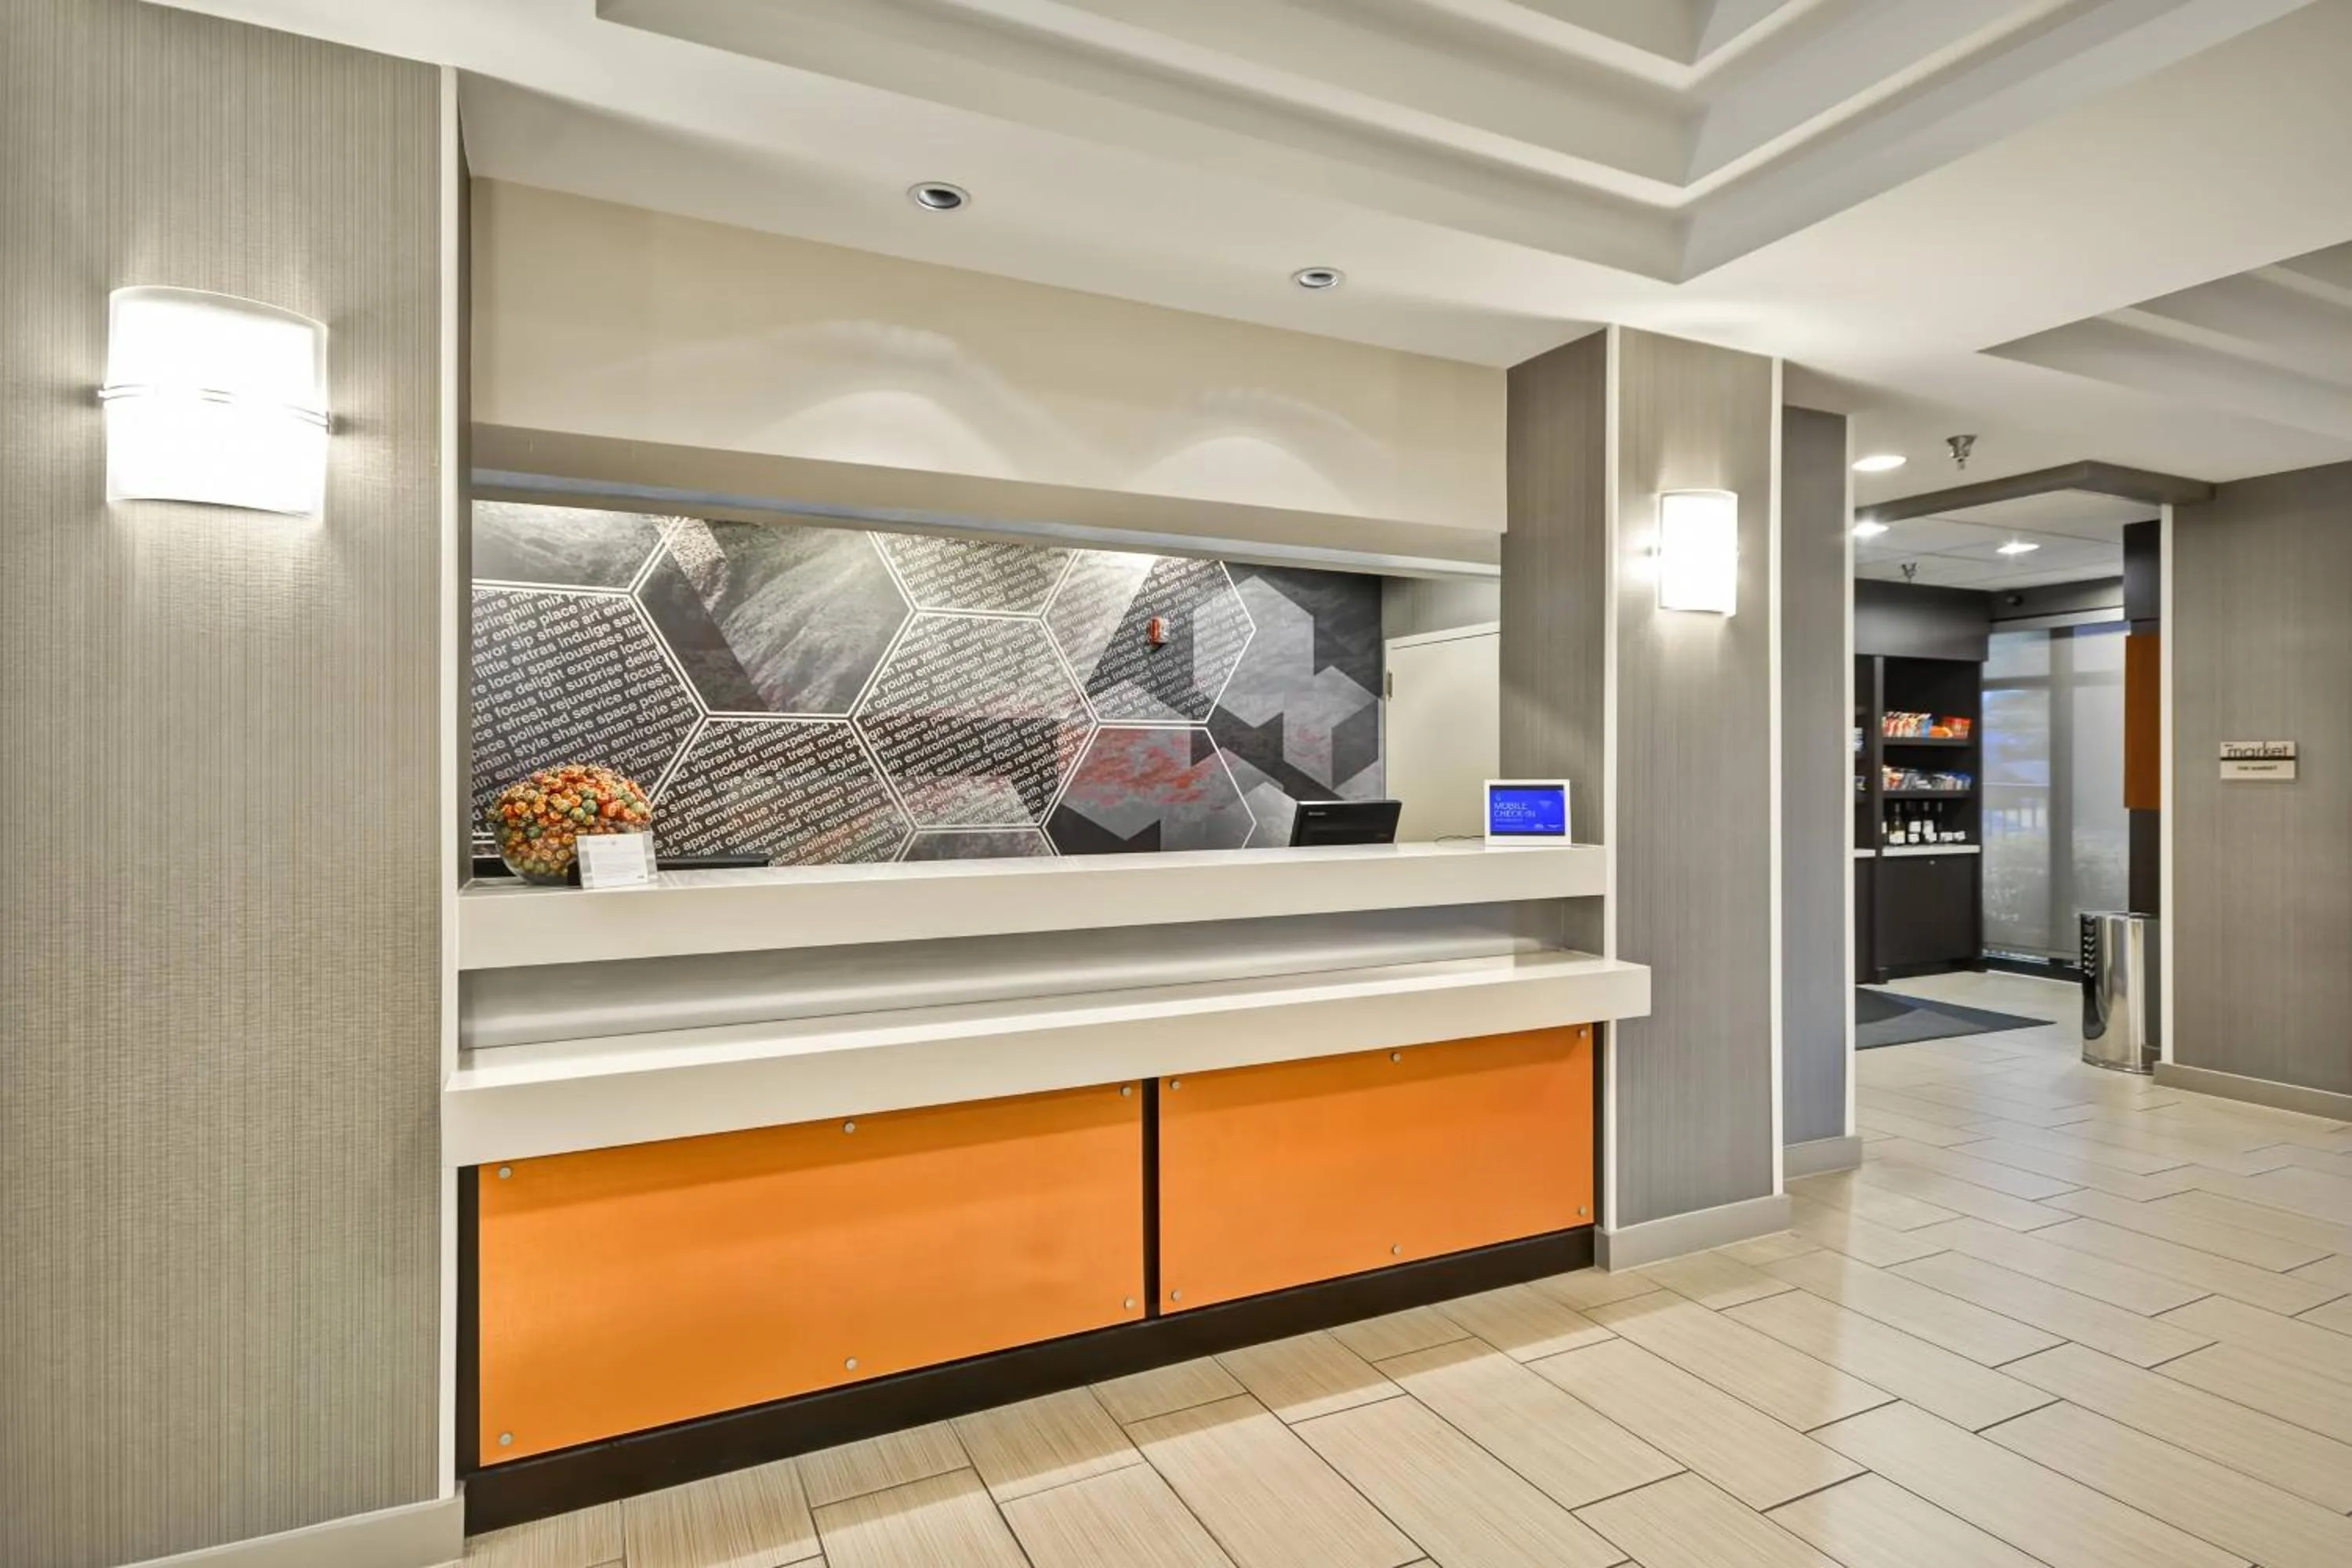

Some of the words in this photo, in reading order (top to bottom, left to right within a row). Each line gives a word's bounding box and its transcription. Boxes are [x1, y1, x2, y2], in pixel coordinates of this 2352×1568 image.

[937, 557, 964, 574] local
[951, 577, 982, 595] focus
[984, 569, 1003, 581] fun
[1182, 568, 1214, 586] human
[492, 619, 537, 642] entice
[539, 605, 576, 629] place
[538, 594, 562, 610] mix
[1152, 599, 1171, 612] hue
[1173, 586, 1199, 604] youth
[475, 660, 508, 679] little
[512, 642, 557, 666] extras
[557, 623, 610, 648] indulge
[512, 635, 532, 649] sip
[537, 620, 578, 641] shake
[582, 608, 601, 624] art
[932, 622, 969, 643] human
[488, 666, 524, 689] local
[528, 633, 623, 675] spaciousness
[515, 668, 564, 695] delight
[567, 650, 618, 676] explore
[875, 679, 928, 707] optimistic
[931, 654, 981, 683] approach
[983, 646, 1004, 659] hue
[1007, 630, 1035, 653] youth
[881, 670, 914, 694] youth
[915, 640, 985, 677] environment
[985, 626, 1021, 646] human
[895, 657, 918, 671] hue
[919, 640, 951, 663] youth
[1102, 648, 1143, 672] polished
[1152, 659, 1173, 673] little
[495, 697, 535, 718] focus
[539, 686, 562, 700] fun
[566, 662, 622, 691] surprise
[496, 704, 547, 733] refresh
[549, 677, 622, 713] rejuvenate
[623, 662, 662, 683] focus
[509, 710, 571, 747] polished
[572, 694, 621, 719] service
[624, 671, 671, 699] refresh
[865, 691, 929, 726] unexpected
[931, 673, 971, 697] vibrant
[972, 652, 1022, 679] optimistic
[886, 712, 912, 729] treat
[914, 695, 956, 717] modern
[958, 665, 1018, 698] unexpected
[895, 720, 927, 739] space
[930, 697, 976, 727] polished
[978, 682, 1015, 702] service
[495, 737, 583, 781] environment
[585, 720, 633, 745] human
[636, 705, 668, 724] style
[514, 737, 549, 757] style
[552, 720, 593, 742] shake
[597, 702, 637, 724] space
[571, 741, 607, 768] youth
[610, 706, 692, 749] environment
[609, 731, 670, 764] approach
[690, 747, 736, 774] vibrant
[739, 722, 799, 753] optimistic
[881, 739, 920, 760] human
[922, 725, 949, 742] style
[952, 710, 982, 728] shake
[904, 725, 972, 763] environment
[974, 711, 1008, 731] human
[905, 746, 956, 775] approach
[958, 738, 979, 752] hue
[980, 720, 1011, 744] youth
[936, 758, 992, 787] rejuvenate
[993, 742, 1023, 760] focus
[1024, 734, 1042, 746] fun
[1044, 713, 1085, 736] surprise
[2227, 741, 2288, 757] market
[626, 745, 671, 771] vibrant
[670, 789, 712, 812] simple
[713, 775, 739, 791] love
[745, 757, 783, 779] design
[787, 741, 814, 759] treat
[677, 774, 706, 793] treat
[710, 753, 757, 779] modern
[760, 720, 829, 757] unexpected
[916, 771, 935, 784] fun
[936, 749, 982, 773] surprise
[983, 729, 1019, 751] delight
[975, 759, 1013, 781] service
[1014, 739, 1051, 762] refresh
[1000, 766, 1030, 784] space
[1032, 742, 1074, 770] polished
[658, 817, 681, 833] mix
[684, 793, 738, 824] pleasure
[742, 775, 773, 794] more
[776, 757, 815, 779] simple
[818, 745, 842, 760] love
[667, 820, 702, 846] youth
[706, 785, 782, 825] environment
[785, 768, 826, 789] human
[828, 753, 855, 770] style
[725, 815, 785, 845] optimistic
[788, 784, 844, 816] approach
[847, 775, 867, 789] hue
[803, 796, 844, 821] vibrant
[682, 815, 742, 848] approach
[745, 807, 768, 822] hue
[770, 787, 804, 813] youth
[776, 822, 816, 846] refresh
[818, 797, 880, 828] rejuvenate
[799, 821, 848, 853] polished
[851, 803, 892, 826] service
[824, 836, 851, 853] style
[854, 819, 888, 839] shake
